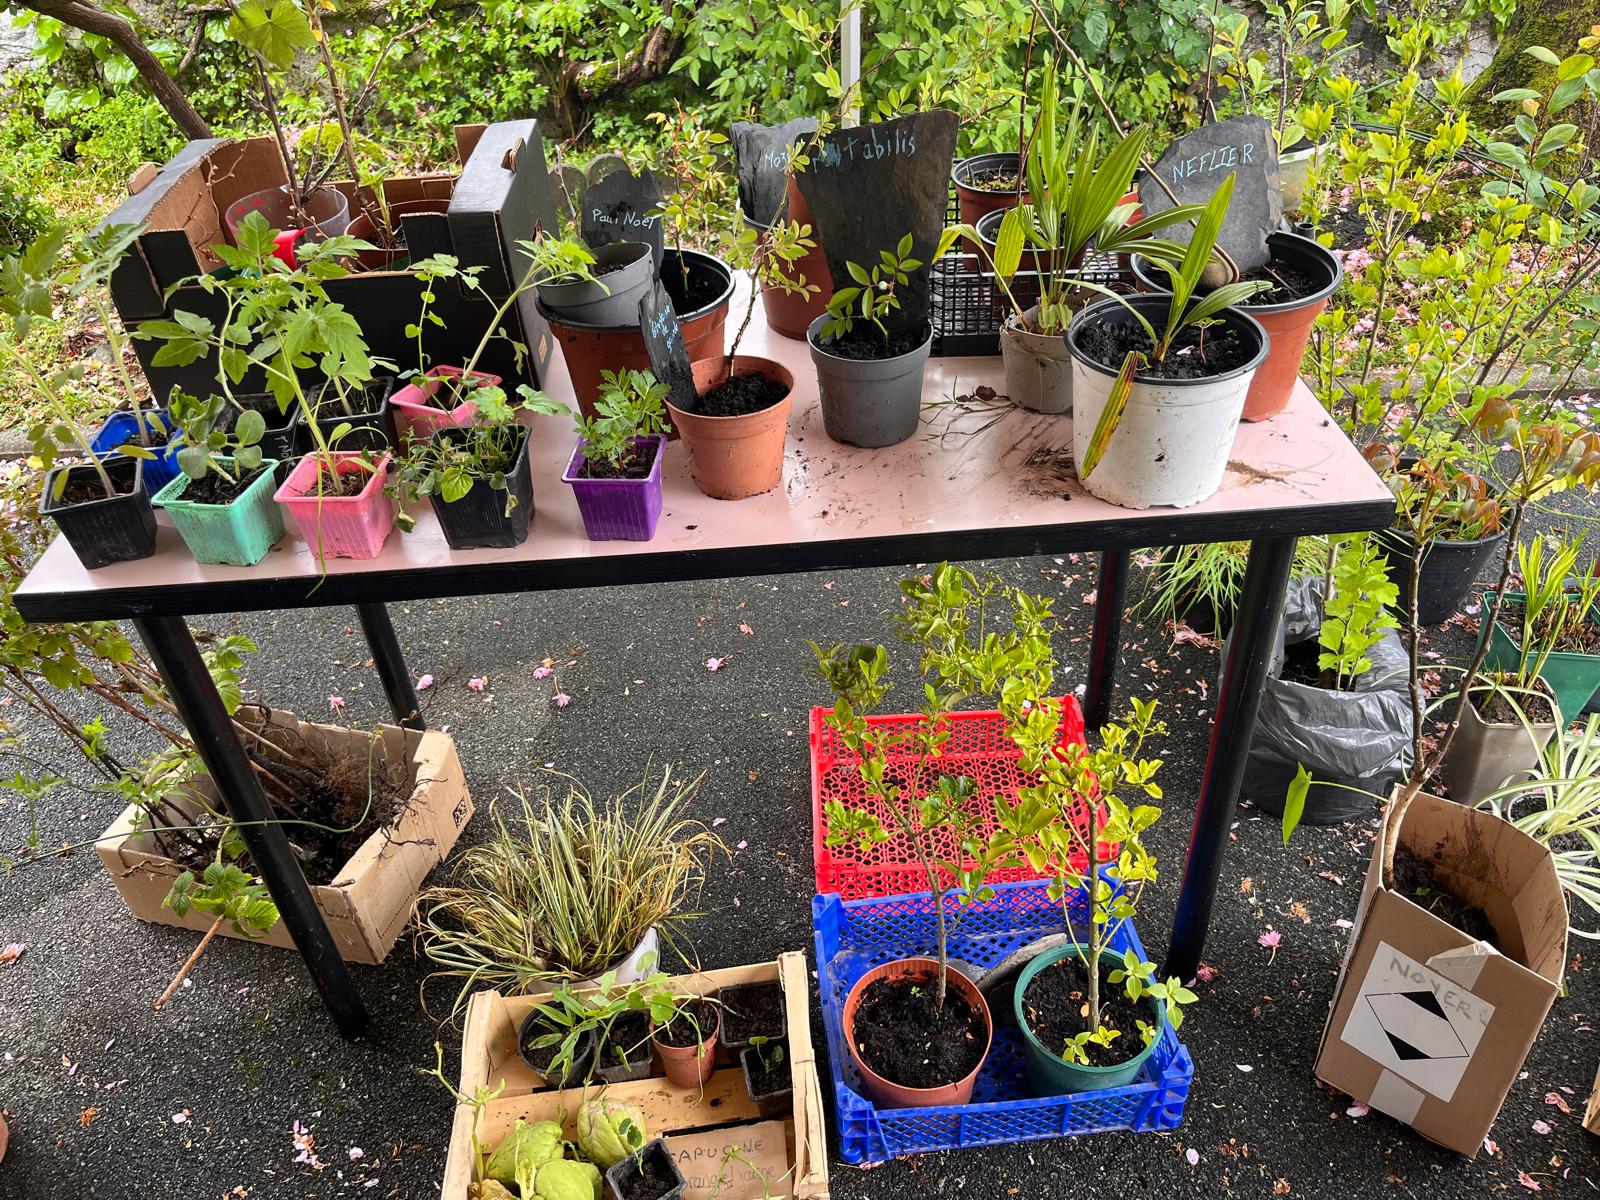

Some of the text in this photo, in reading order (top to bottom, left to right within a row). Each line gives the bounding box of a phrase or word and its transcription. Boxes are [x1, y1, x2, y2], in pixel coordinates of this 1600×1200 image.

[1172, 143, 1254, 184] NEFLIER
[592, 208, 619, 225] Paul
[1389, 957, 1472, 1020] NOYER
[670, 1139, 765, 1163] APUCNE
